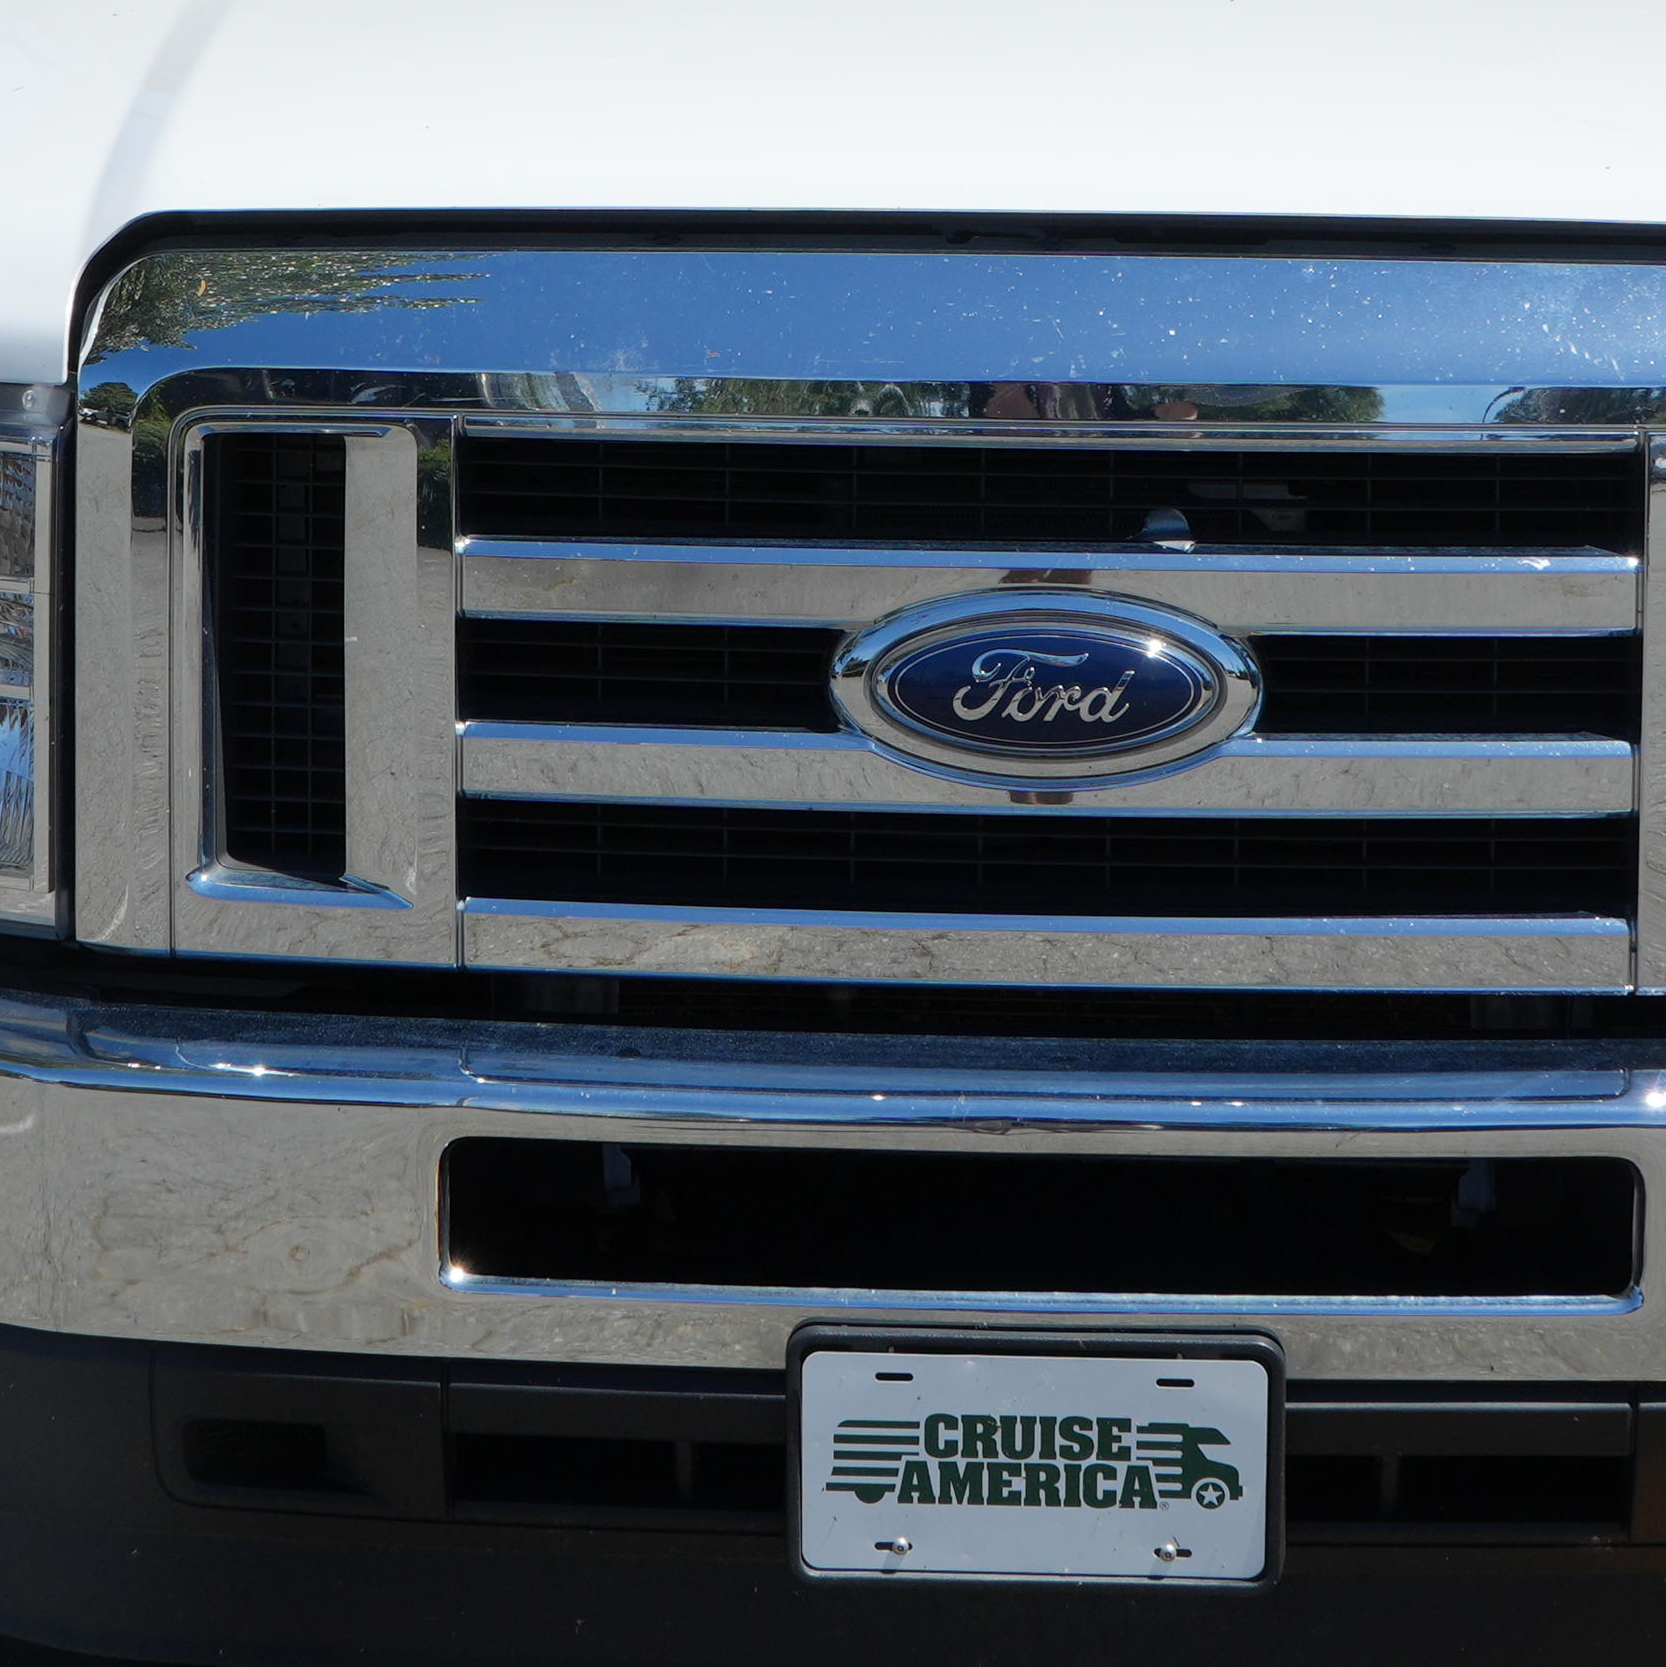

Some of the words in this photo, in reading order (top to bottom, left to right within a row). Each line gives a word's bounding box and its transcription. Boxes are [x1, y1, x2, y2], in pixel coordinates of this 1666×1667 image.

[951, 648, 1136, 723] Ford
[923, 1413, 1133, 1461] CRUISE
[897, 1460, 1158, 1509] AMERICA
